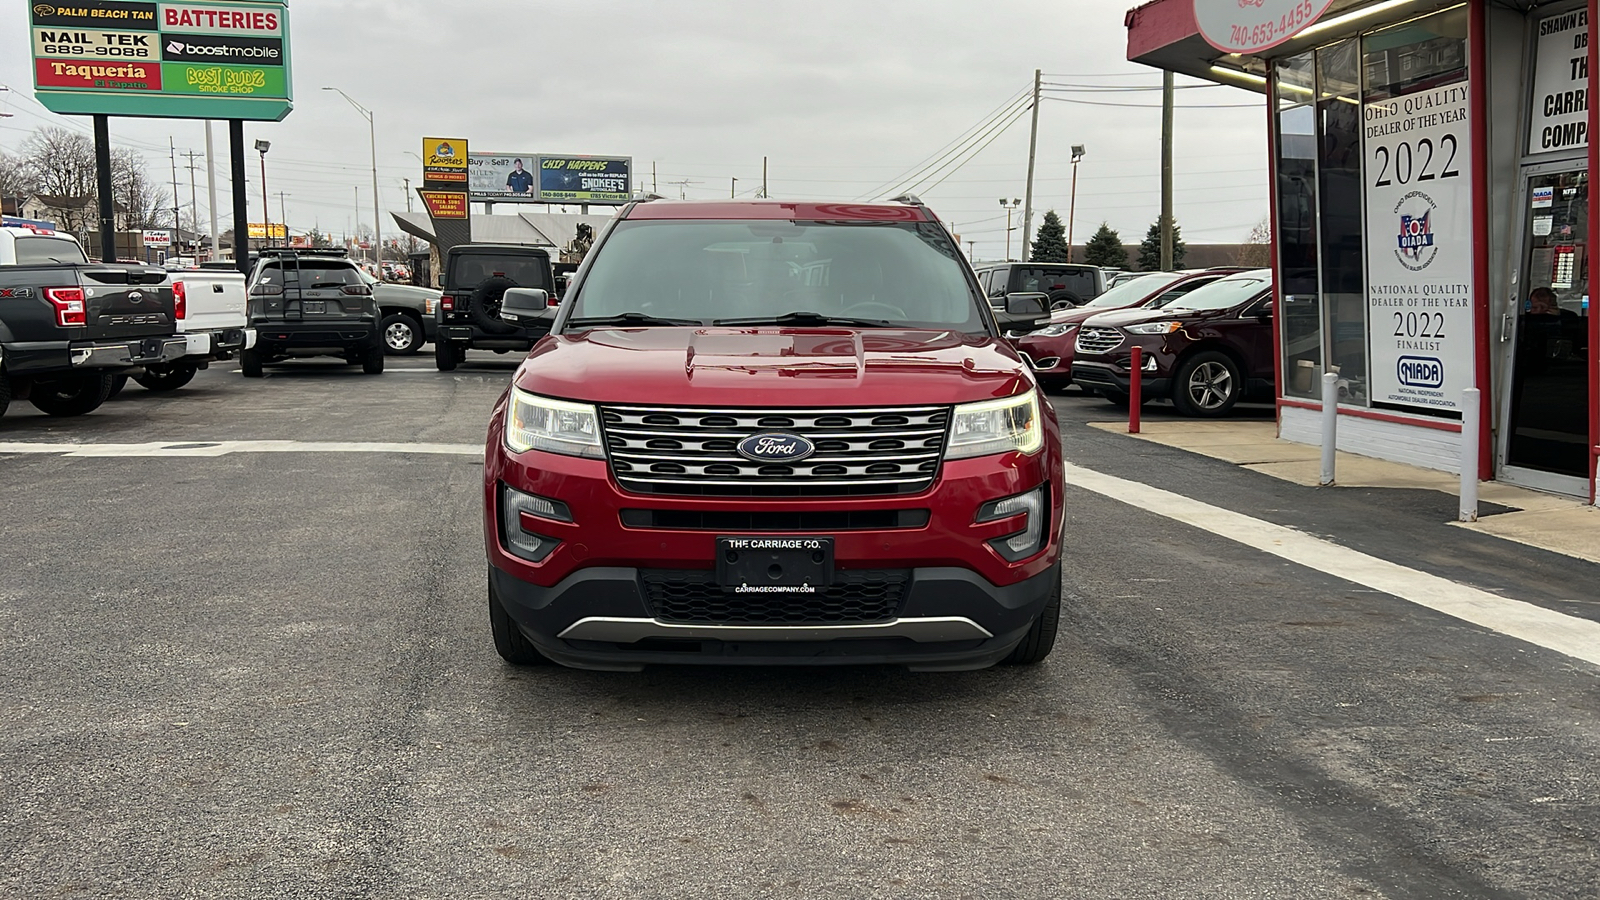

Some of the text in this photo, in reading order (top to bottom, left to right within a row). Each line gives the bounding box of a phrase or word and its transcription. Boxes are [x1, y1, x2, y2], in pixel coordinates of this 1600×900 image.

[57, 7, 154, 20] PALM BEACH TAN
[165, 8, 278, 31] BATTERIES
[1229, 0, 1313, 46] 740-653-4455
[1540, 13, 1577, 37] SHAWN
[41, 31, 149, 47] NAIL TEK
[44, 44, 149, 58] 689-9088
[230, 86, 254, 94] SHOP
[1365, 85, 1469, 122] OHIO QUALITY
[1367, 107, 1467, 139] DEALER OF THE YEAR
[428, 154, 463, 165] Roosters
[468, 159, 484, 167] Buy
[541, 159, 609, 171] CHIP HAPPENS
[1374, 133, 1460, 188] 2022
[581, 178, 625, 190] SNOKEE'S
[1402, 235, 1428, 247] OIADA
[1370, 284, 1470, 295] NATIONAL QUALITY
[1371, 298, 1469, 307] DEALER OF THE YEAR
[1393, 311, 1445, 339] 2022
[1397, 340, 1440, 351] FINALIST
[1401, 362, 1439, 382] NIADA
[754, 437, 796, 455] Ford
[729, 540, 821, 549] THE CARRIAGE CO.
[735, 585, 815, 593] CARRIAGECOMPANY.COM
